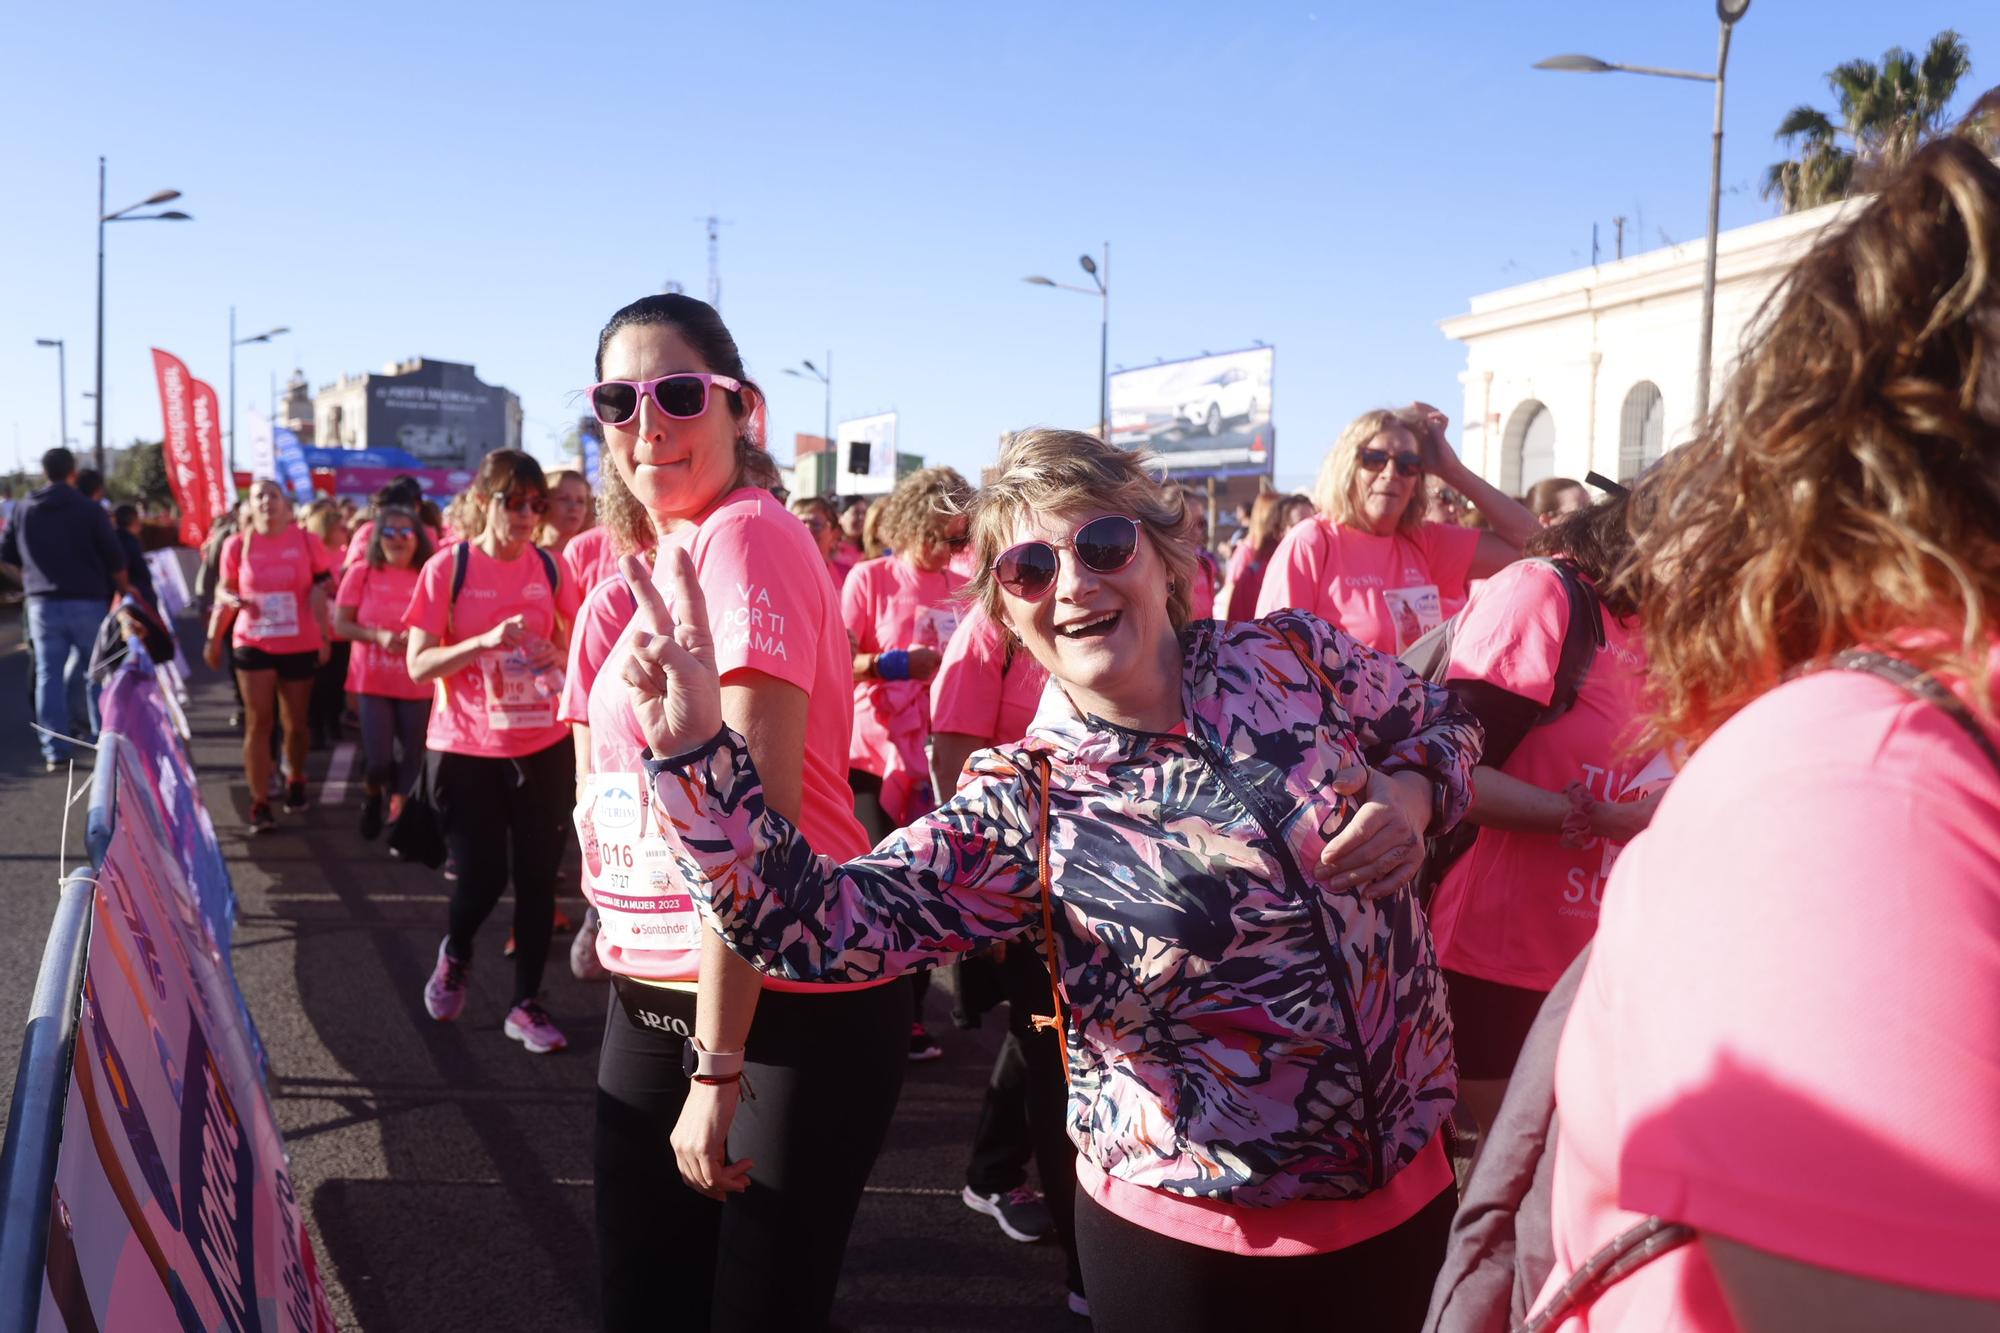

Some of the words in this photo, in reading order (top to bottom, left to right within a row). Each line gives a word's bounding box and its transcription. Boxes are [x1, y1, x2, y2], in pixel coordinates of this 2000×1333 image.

[736, 582, 771, 608] VA
[724, 607, 763, 631] POR
[768, 612, 784, 635] TI
[602, 843, 633, 868] 016
[630, 900, 655, 910] MUJER
[658, 899, 680, 910] 2023
[641, 923, 688, 935] Santander
